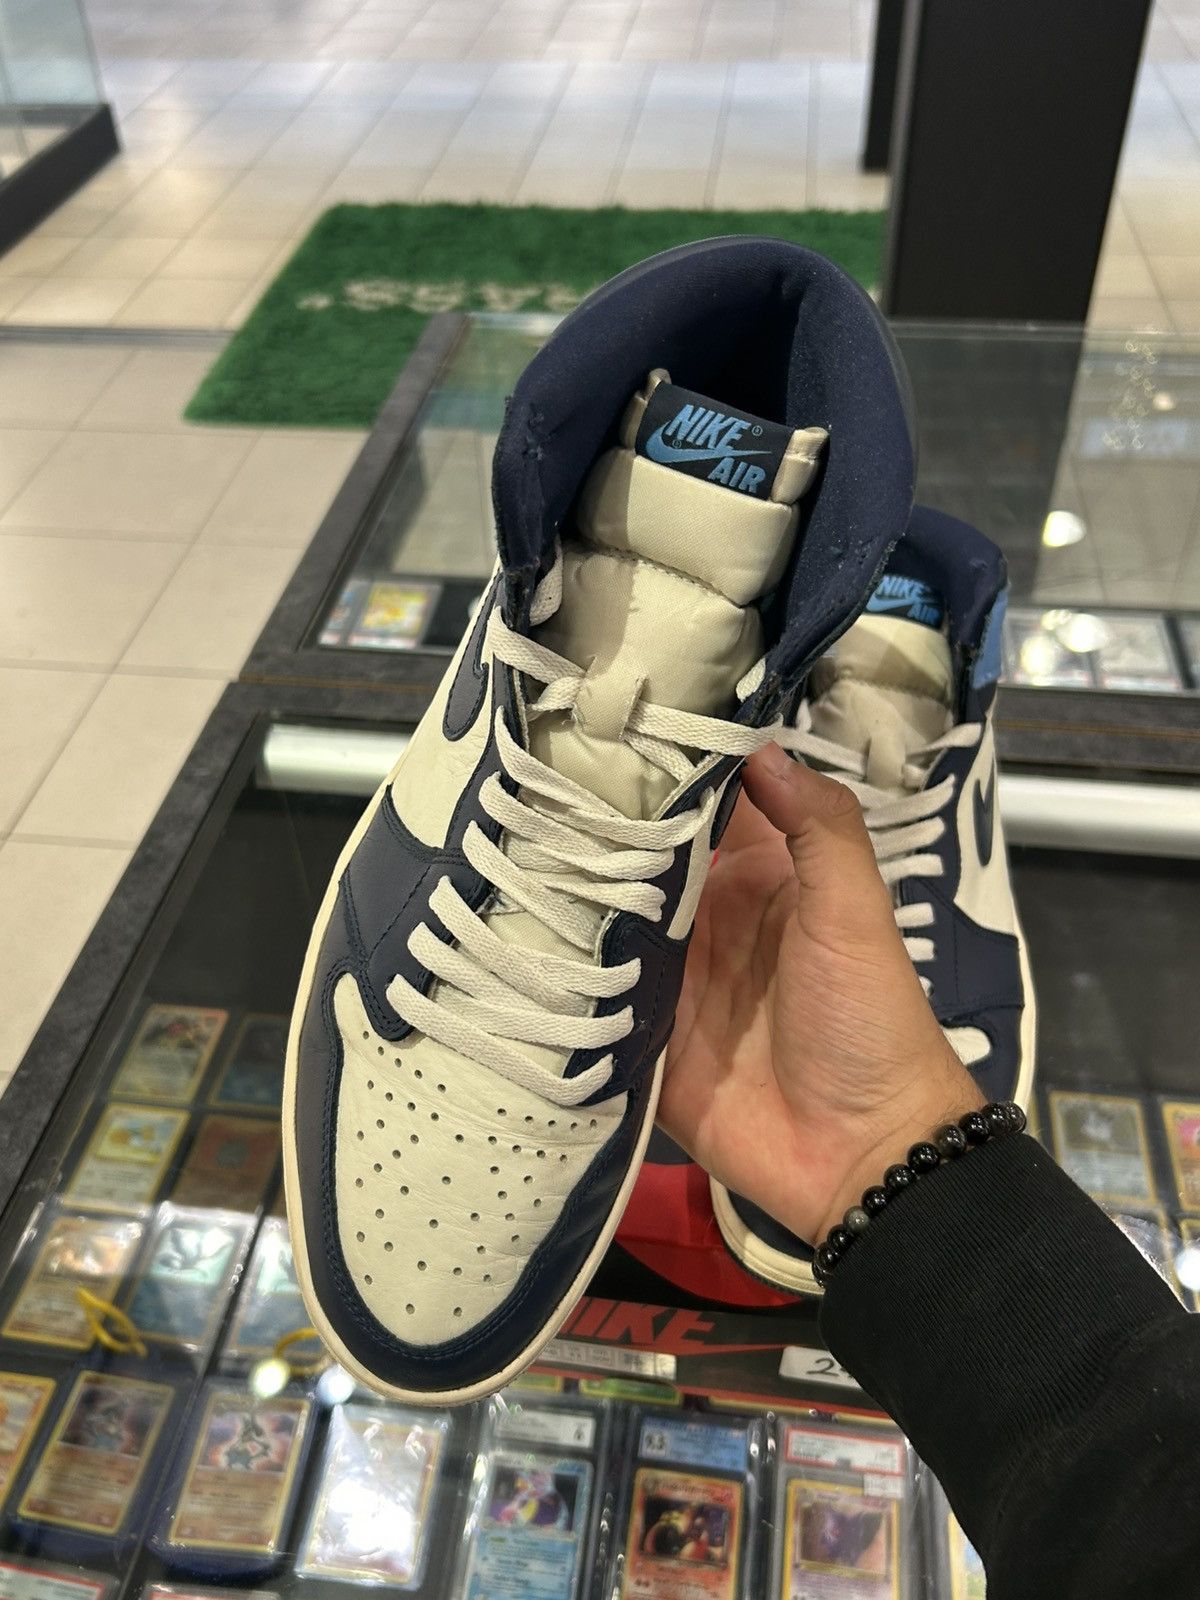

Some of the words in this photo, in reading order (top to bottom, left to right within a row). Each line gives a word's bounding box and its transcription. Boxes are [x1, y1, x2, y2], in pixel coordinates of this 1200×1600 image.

[665, 404, 752, 451] NIKE
[707, 457, 766, 493] AIR
[875, 575, 925, 600] NIKE
[907, 603, 940, 625] AIR
